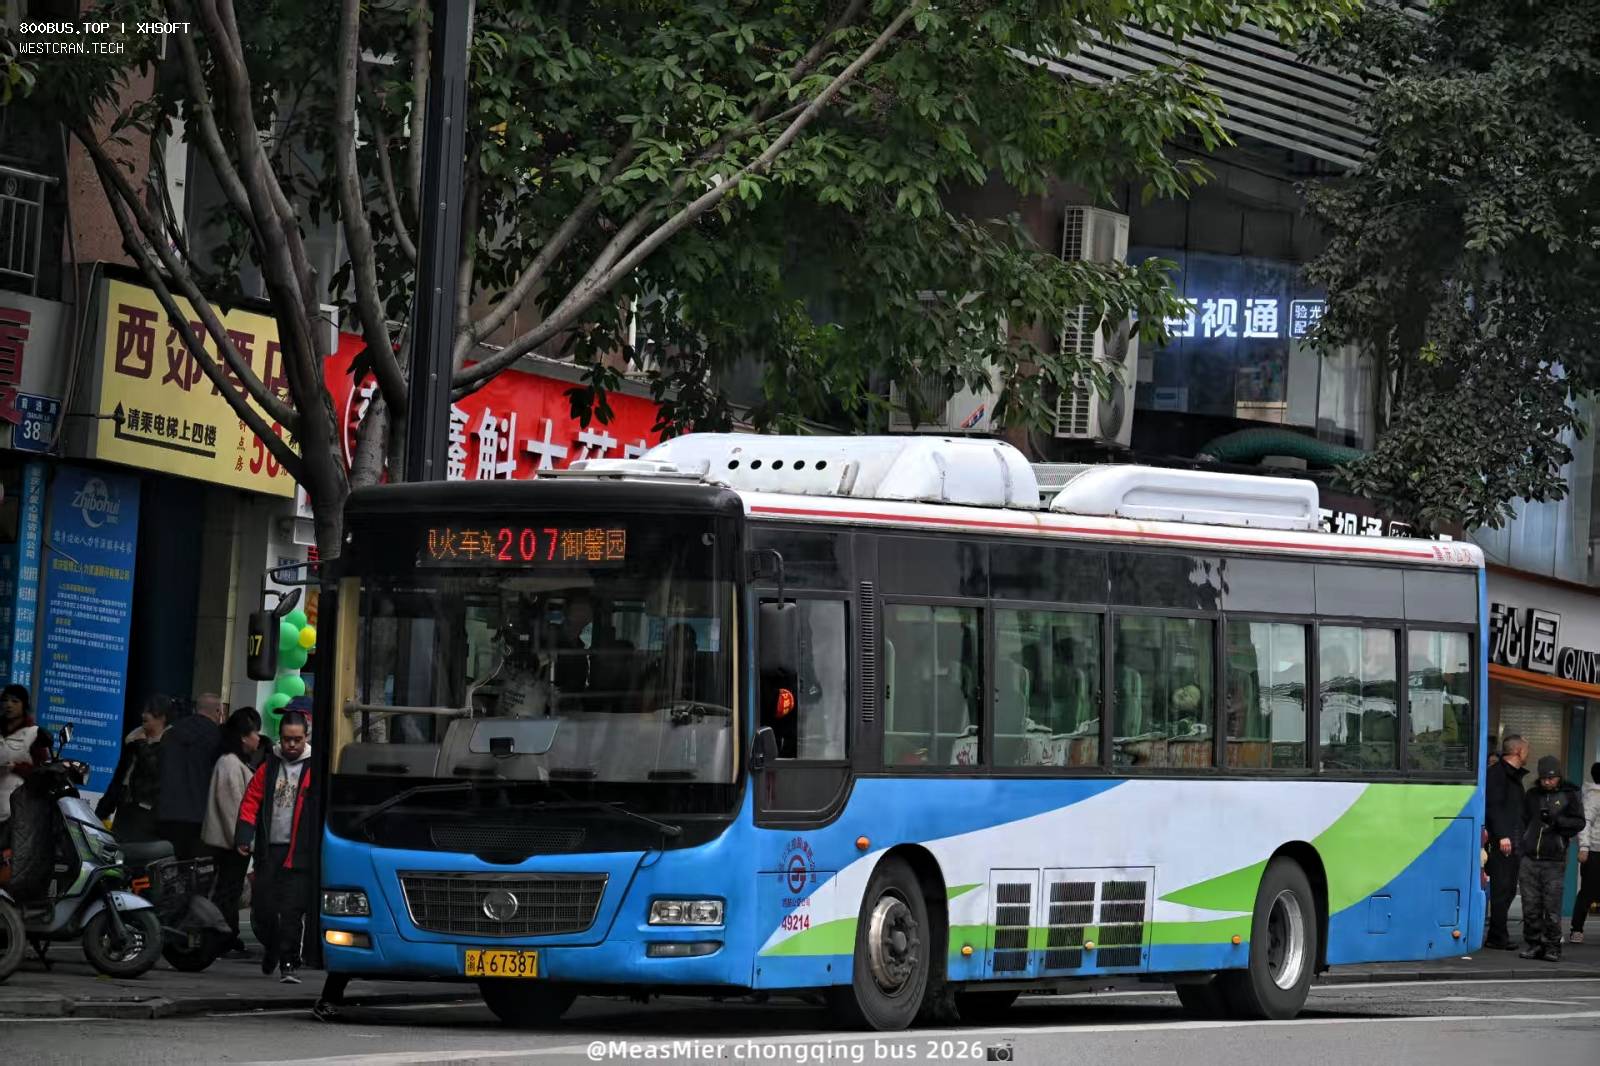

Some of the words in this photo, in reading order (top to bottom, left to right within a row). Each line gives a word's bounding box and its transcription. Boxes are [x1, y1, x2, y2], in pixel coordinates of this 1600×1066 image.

[1294, 304, 1328, 319] 验光
[23, 420, 41, 441] 38
[127, 408, 217, 447] 请乘电梯上四楼
[497, 528, 560, 560] 207
[561, 528, 627, 560] 御馨园
[1490, 602, 1561, 674] 沁园
[781, 914, 810, 931] 49214
